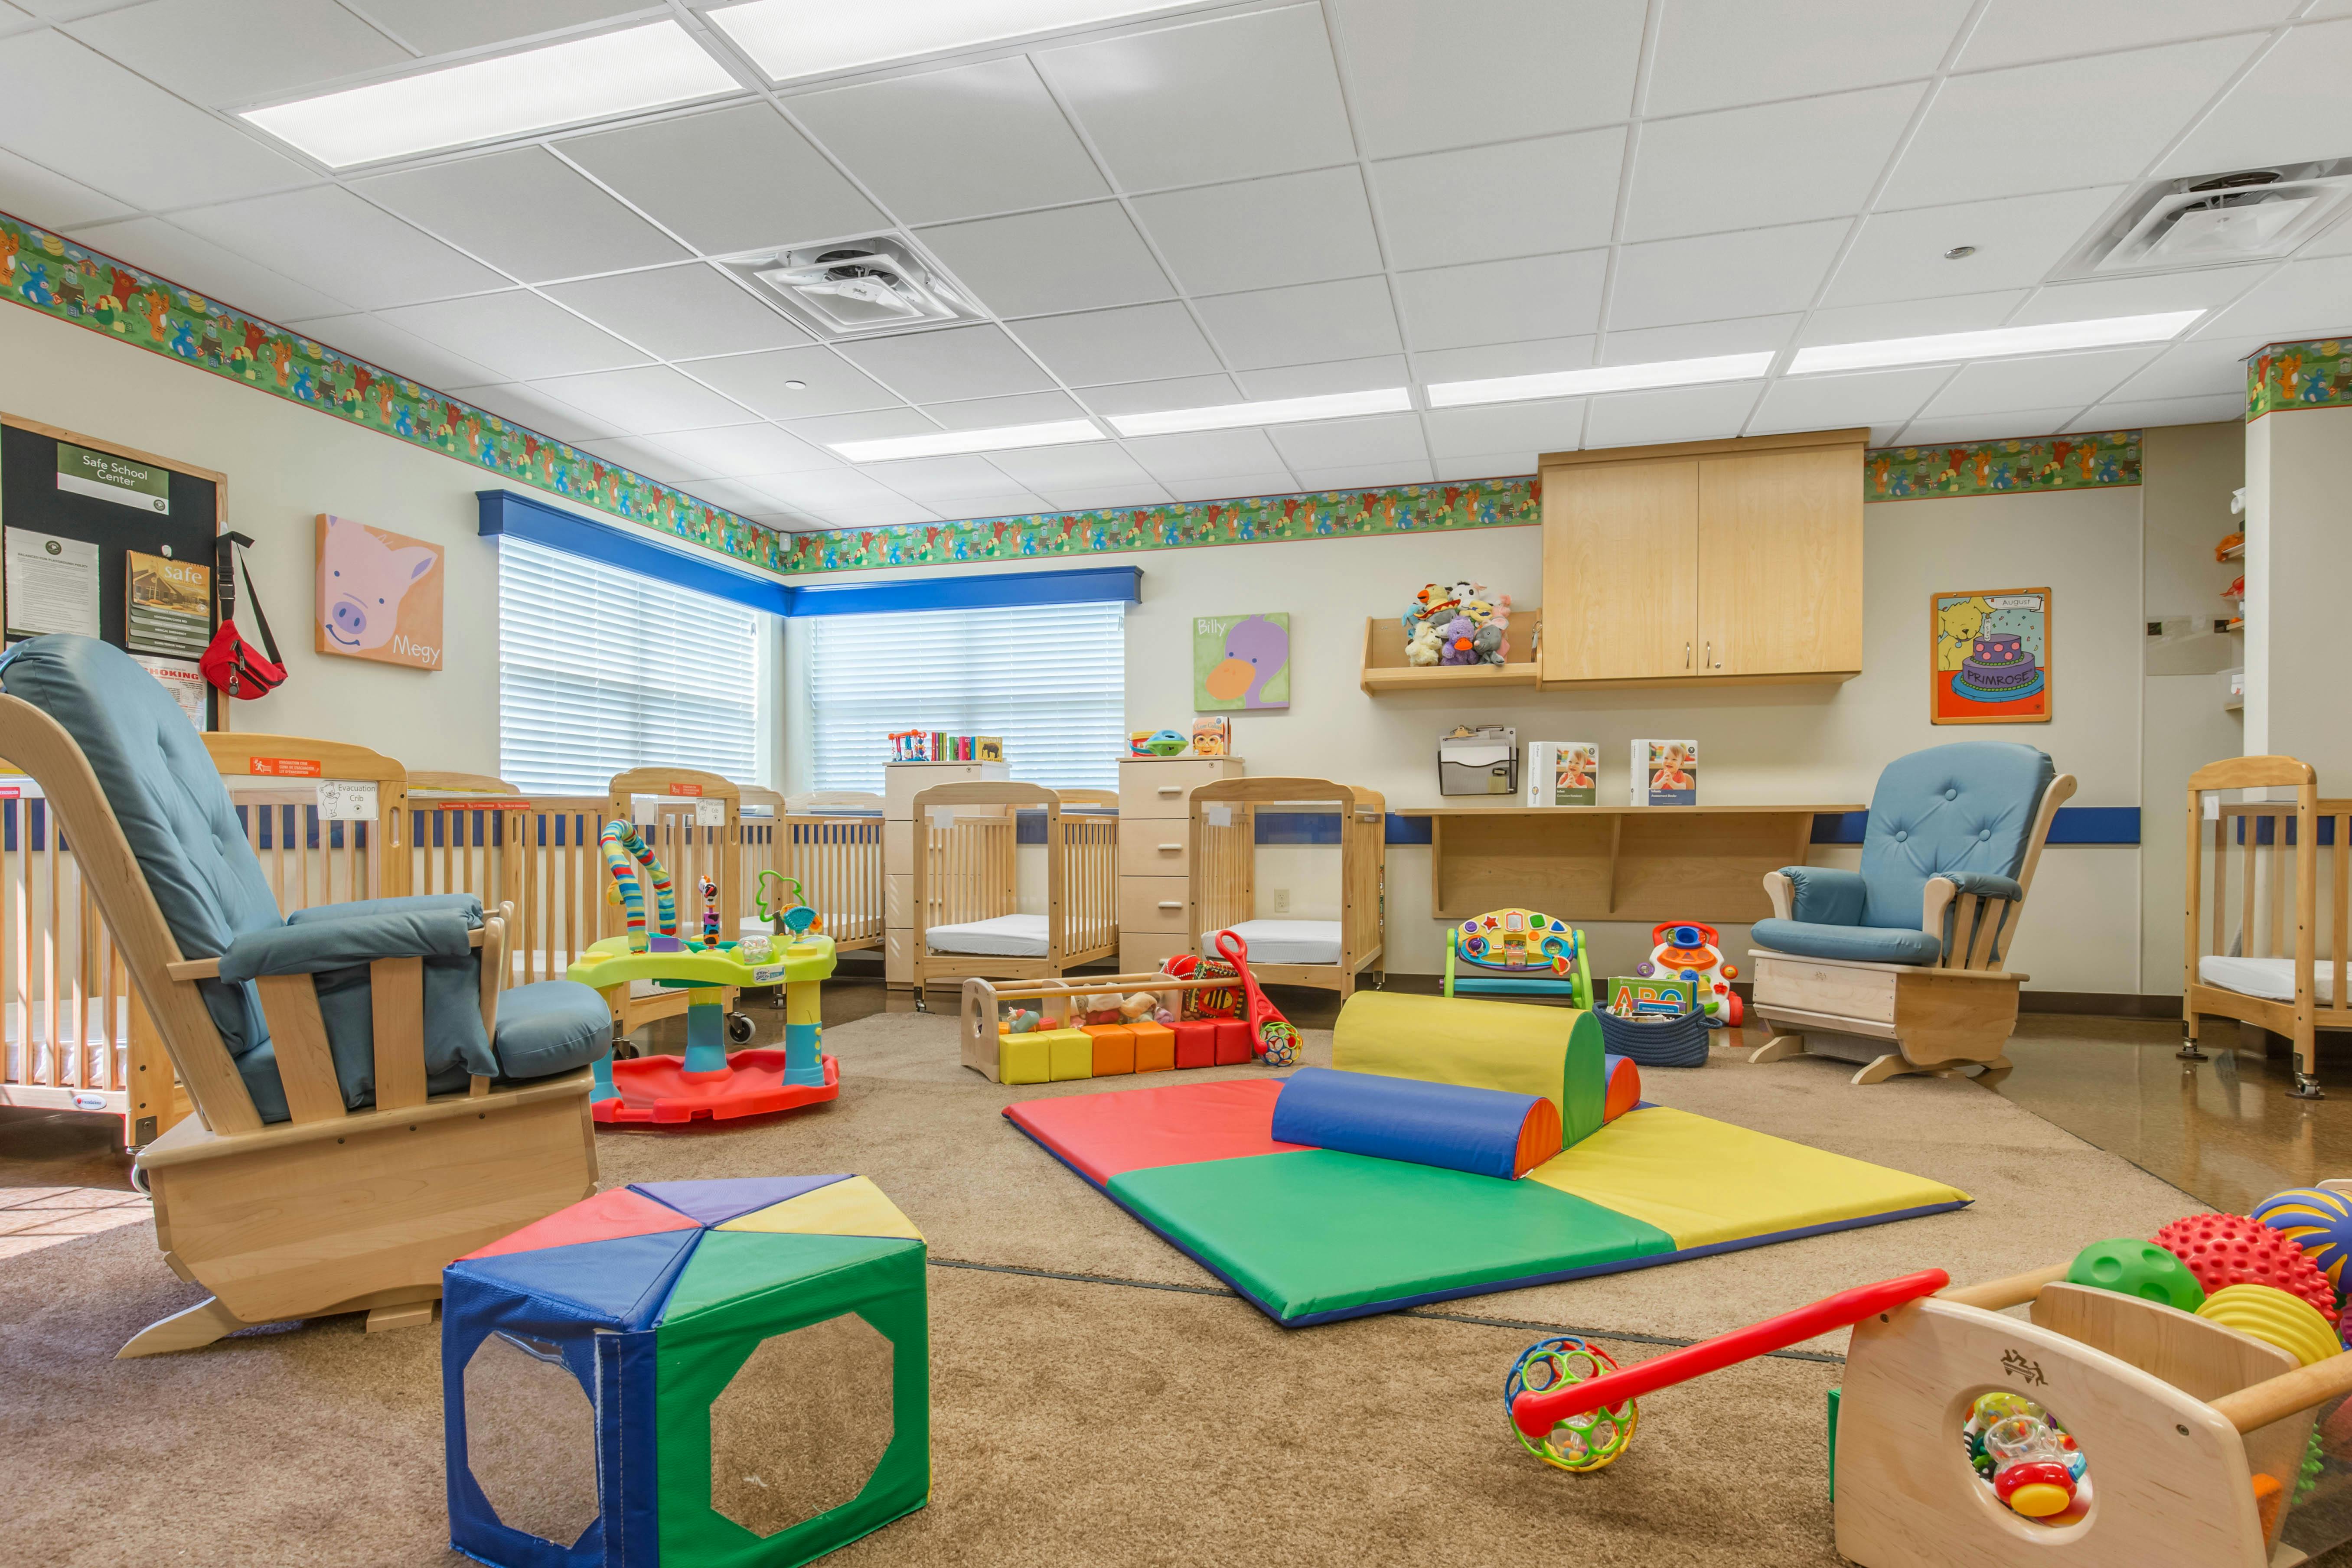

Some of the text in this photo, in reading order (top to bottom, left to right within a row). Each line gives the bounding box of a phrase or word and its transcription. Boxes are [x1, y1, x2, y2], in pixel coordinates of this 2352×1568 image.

[83, 455, 147, 480] Safe School
[97, 469, 135, 486] Center
[164, 566, 202, 584] safe
[1197, 619, 1227, 637] Billy
[393, 634, 440, 665] Megy
[145, 668, 199, 680] HOKING
[1967, 670, 2029, 686] PRIMROSE
